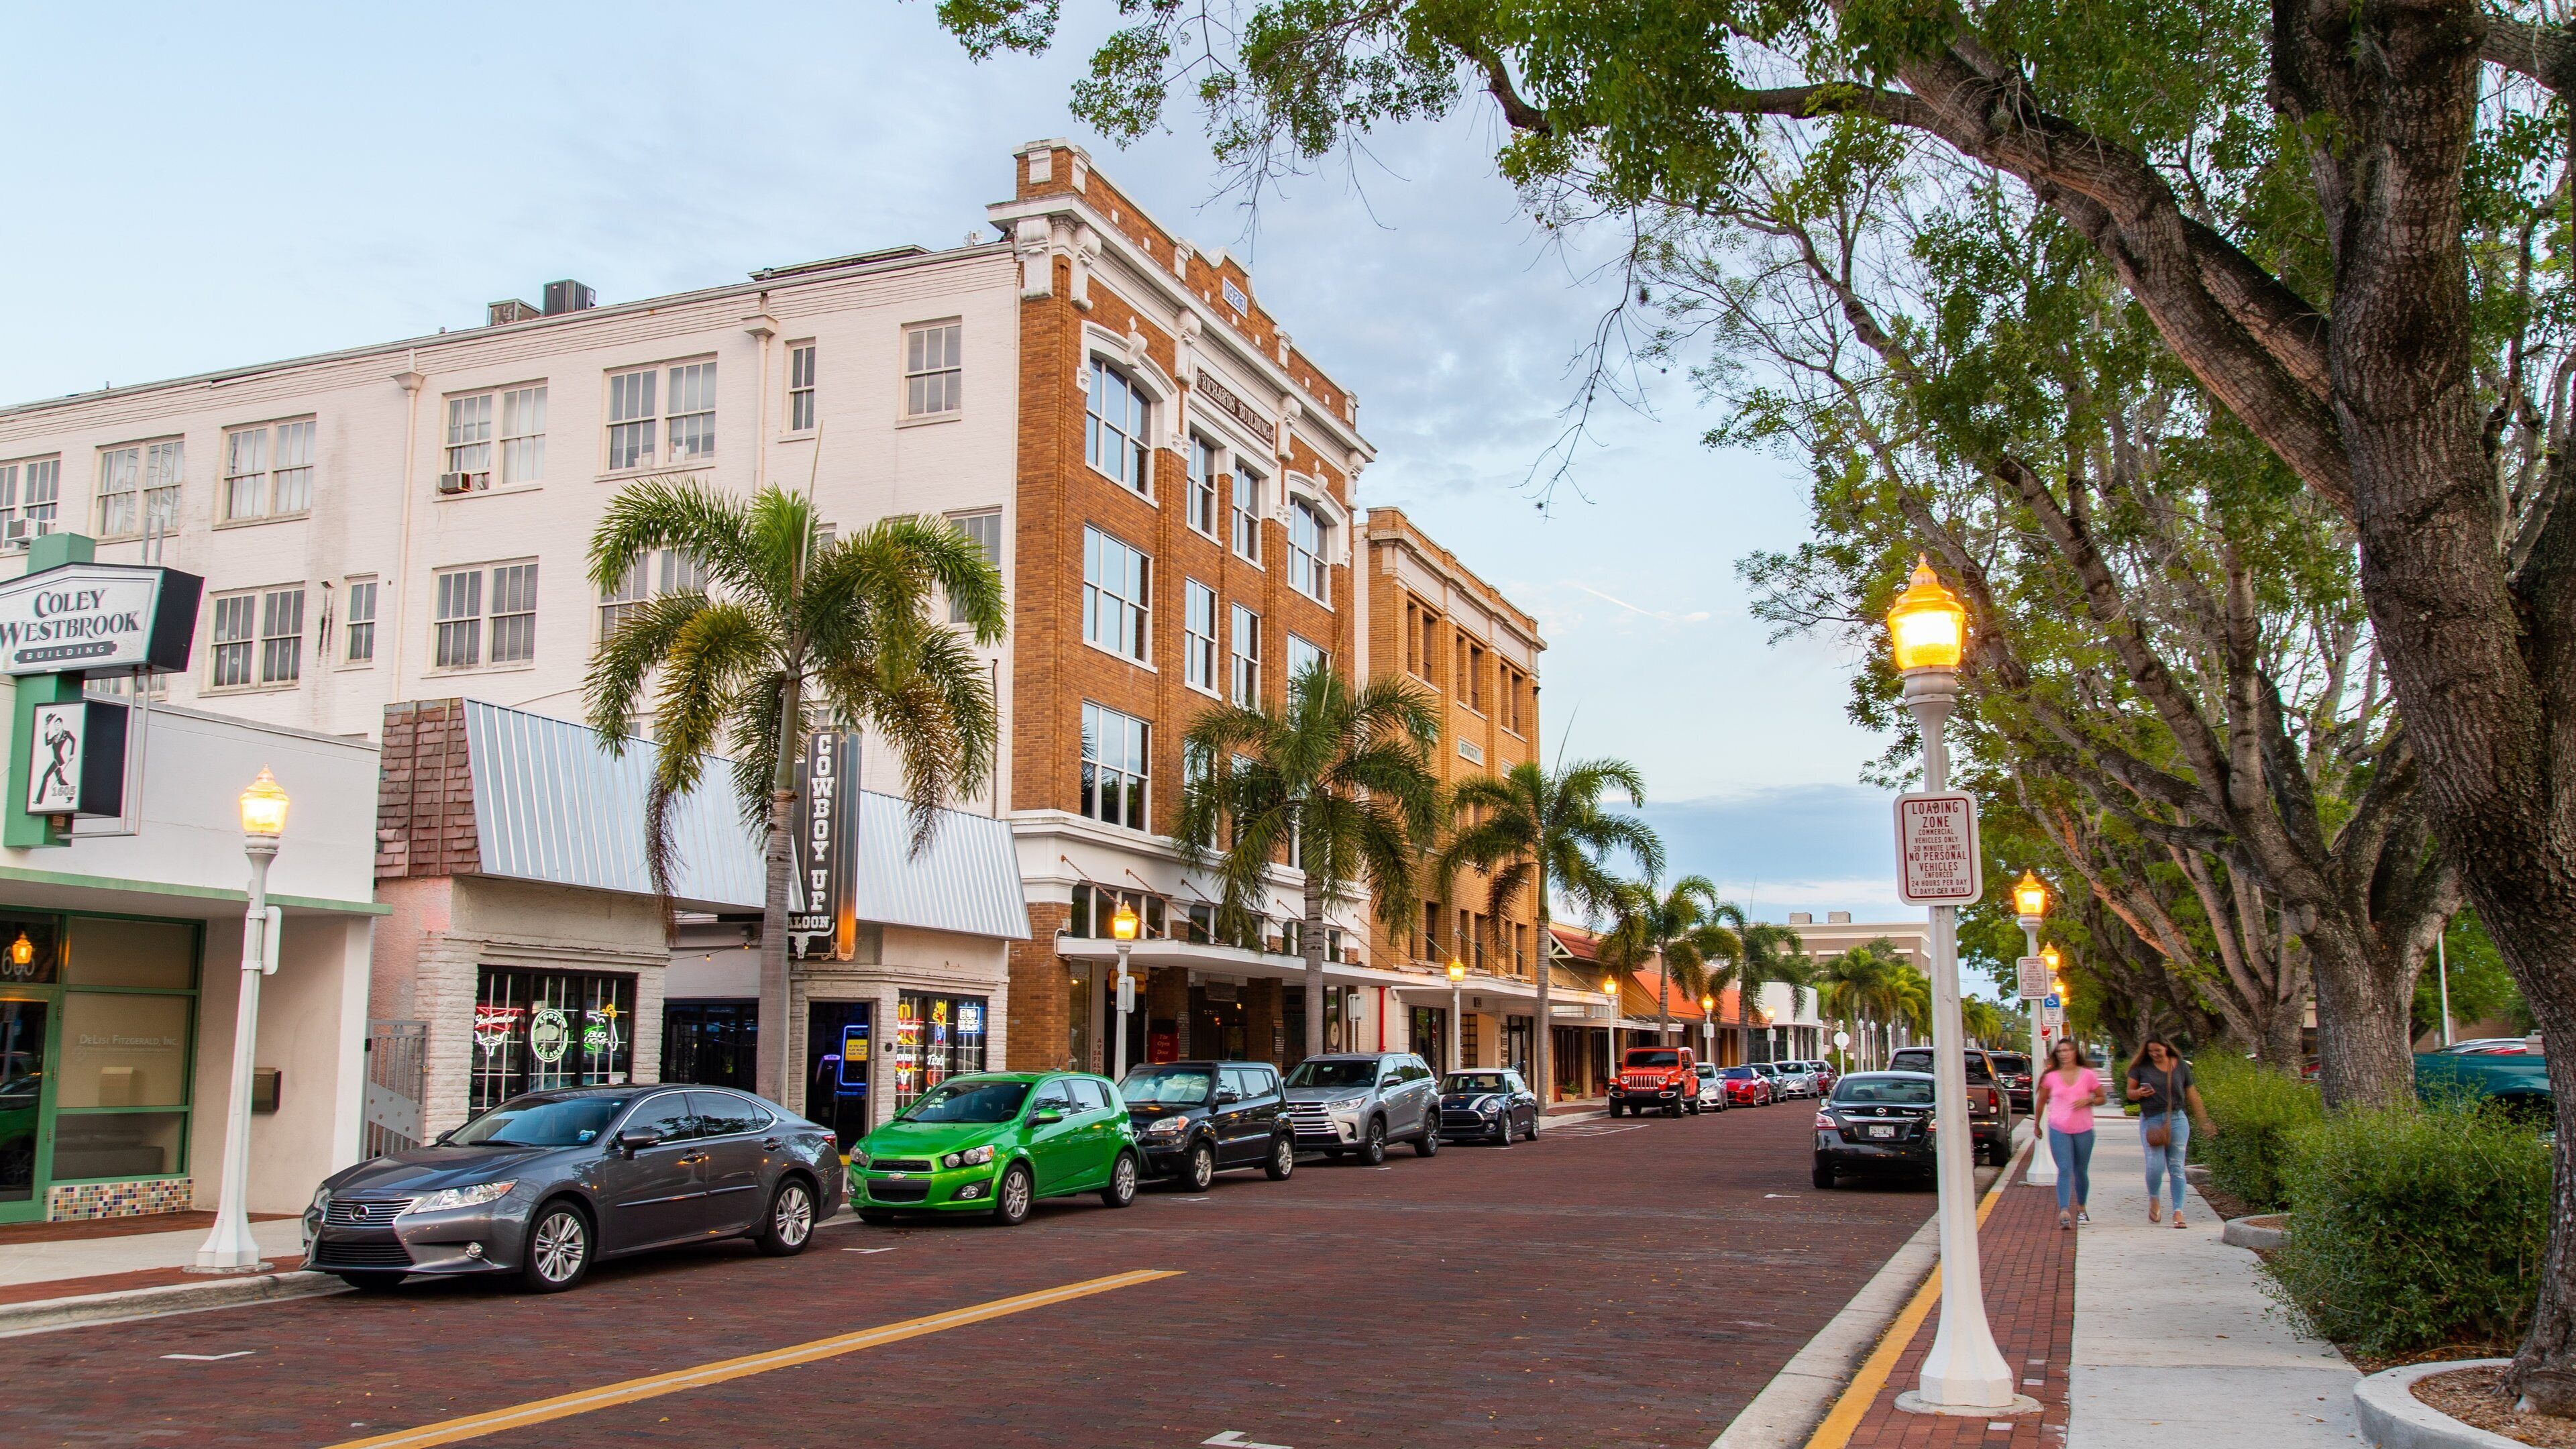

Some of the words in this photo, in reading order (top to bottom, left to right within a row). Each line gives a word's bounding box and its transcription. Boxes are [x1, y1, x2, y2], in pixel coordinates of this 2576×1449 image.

[1225, 282, 1244, 312] 1923
[1201, 372, 1235, 413] RICHARDS
[1238, 402, 1270, 439] BUILDING
[35, 588, 109, 618] COLEY
[0, 611, 141, 649] WESTBROOK
[26, 645, 105, 659] BUILDING
[811, 735, 835, 861] COWBOY
[1912, 802, 1958, 814] LOADING
[1923, 816, 1950, 828] ZONE
[1909, 852, 1919, 861] NO
[1924, 851, 1967, 861] PERSONAL
[1919, 862, 1958, 871] VEHICLES
[810, 869, 828, 912] UP
[788, 916, 830, 928] ALOON
[539, 1014, 561, 1024] GOOSE
[538, 1045, 561, 1058] ISLAND
